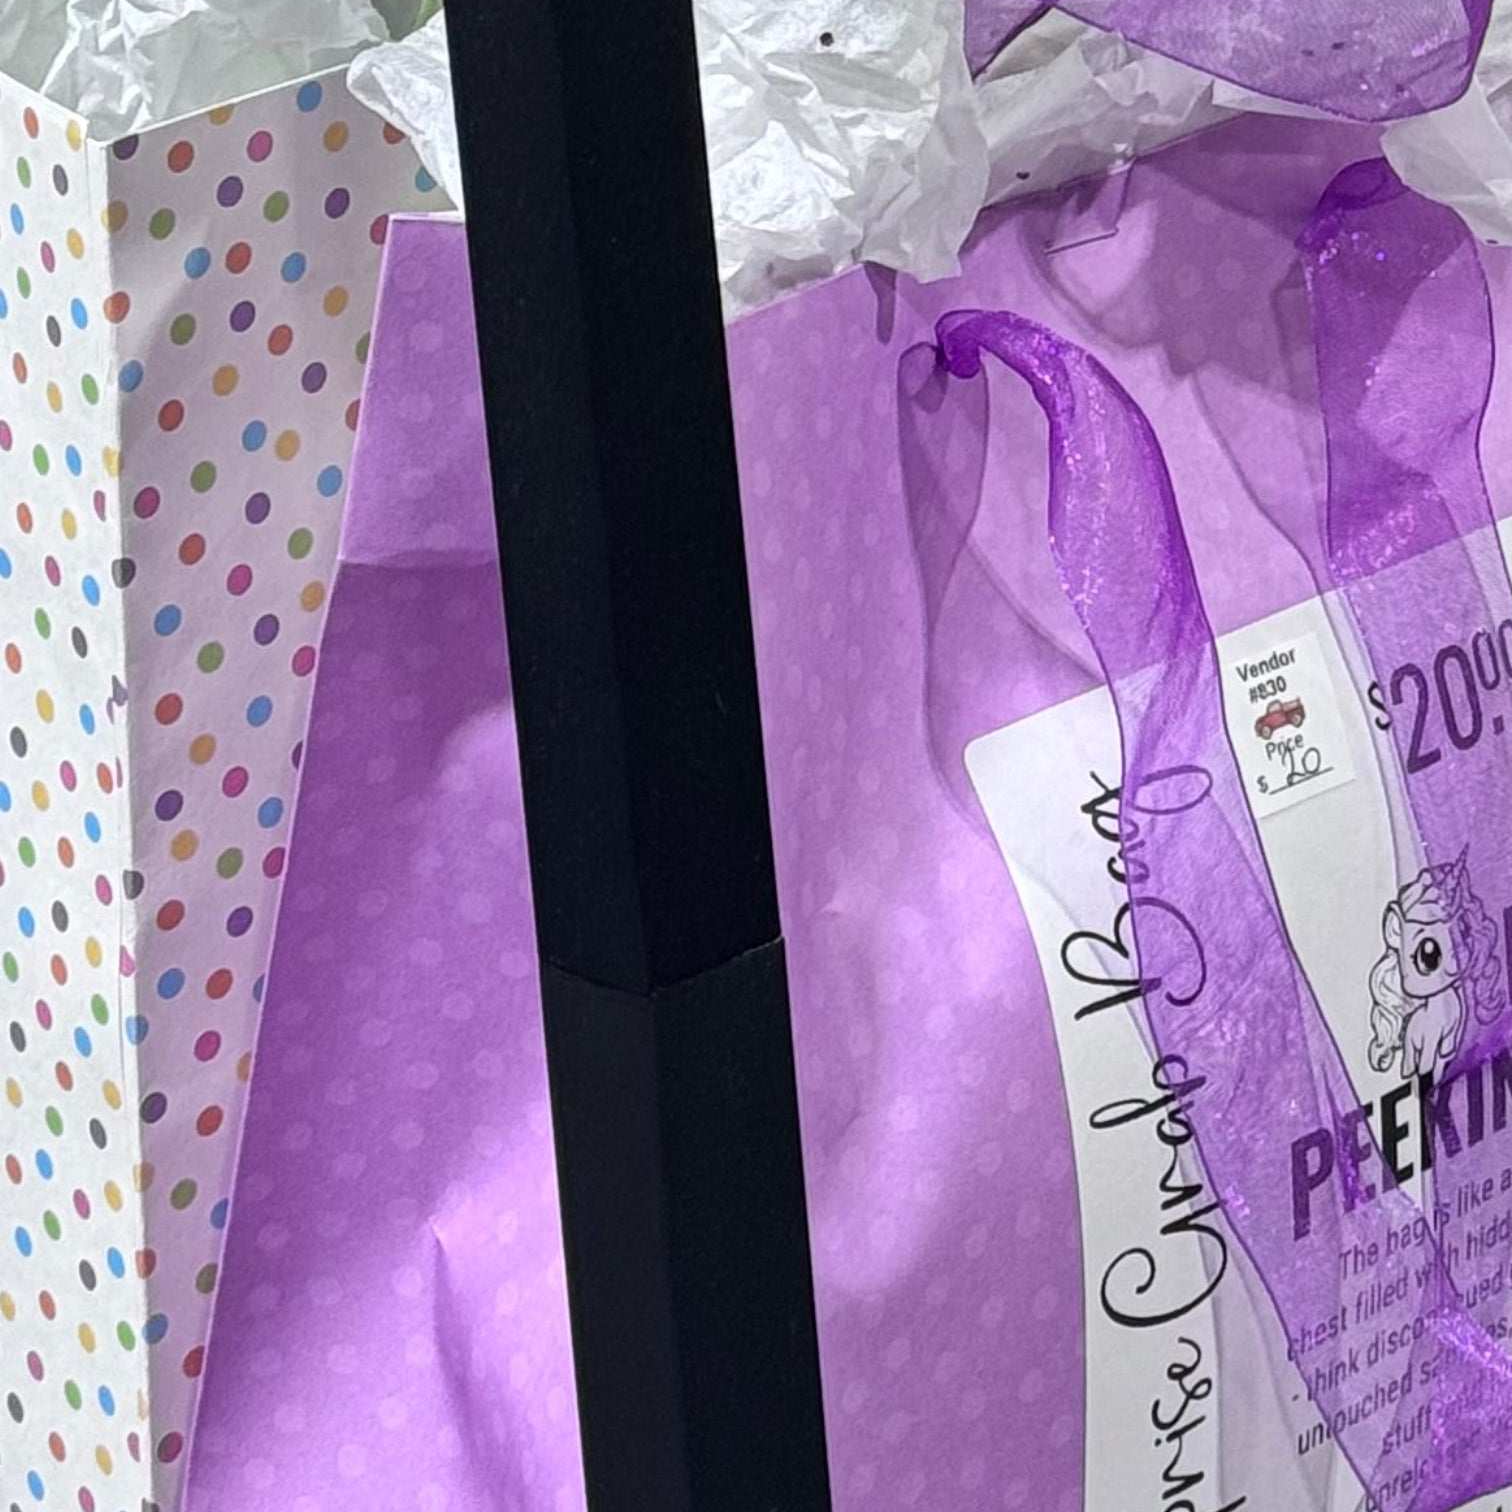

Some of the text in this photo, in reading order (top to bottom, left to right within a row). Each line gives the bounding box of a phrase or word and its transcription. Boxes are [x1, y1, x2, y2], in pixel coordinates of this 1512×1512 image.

[1236, 648, 1296, 683] Vendor
[1249, 675, 1287, 704] #830
[1062, 765, 1213, 1019] Bag
[1089, 1054, 1227, 1327] Grab
[1339, 1242, 1378, 1280] The
[1458, 1178, 1494, 1218] like
[1501, 1168, 1512, 1193] a
[1356, 1267, 1408, 1323] filled
